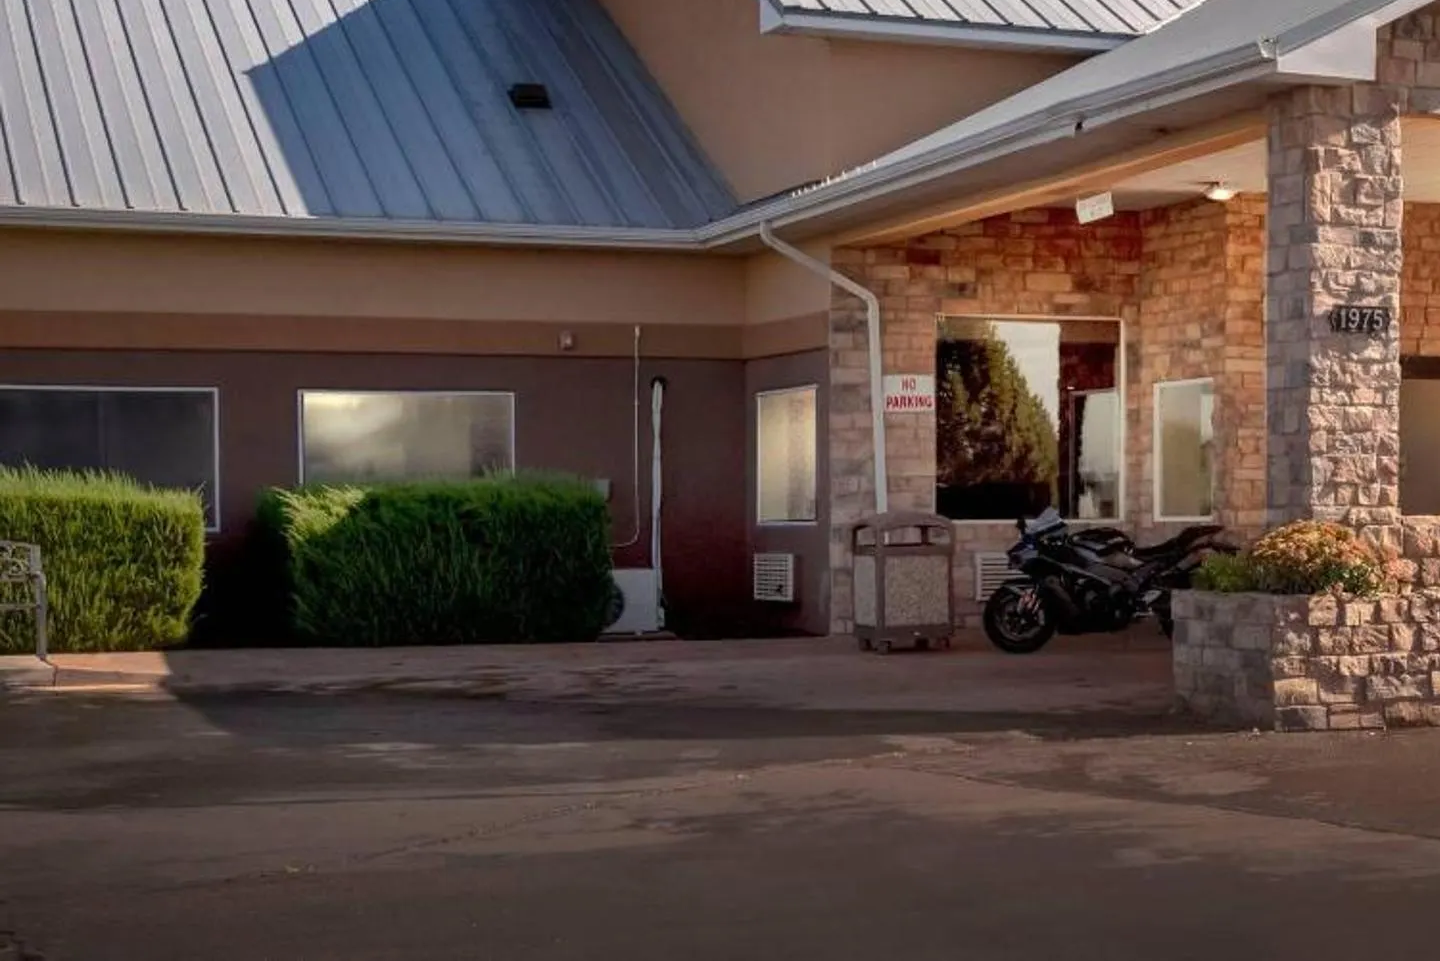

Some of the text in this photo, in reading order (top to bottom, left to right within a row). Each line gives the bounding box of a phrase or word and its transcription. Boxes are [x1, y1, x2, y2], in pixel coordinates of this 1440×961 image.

[1340, 308, 1384, 329] 1975
[901, 378, 917, 391] NO
[886, 394, 933, 409] PARKING
